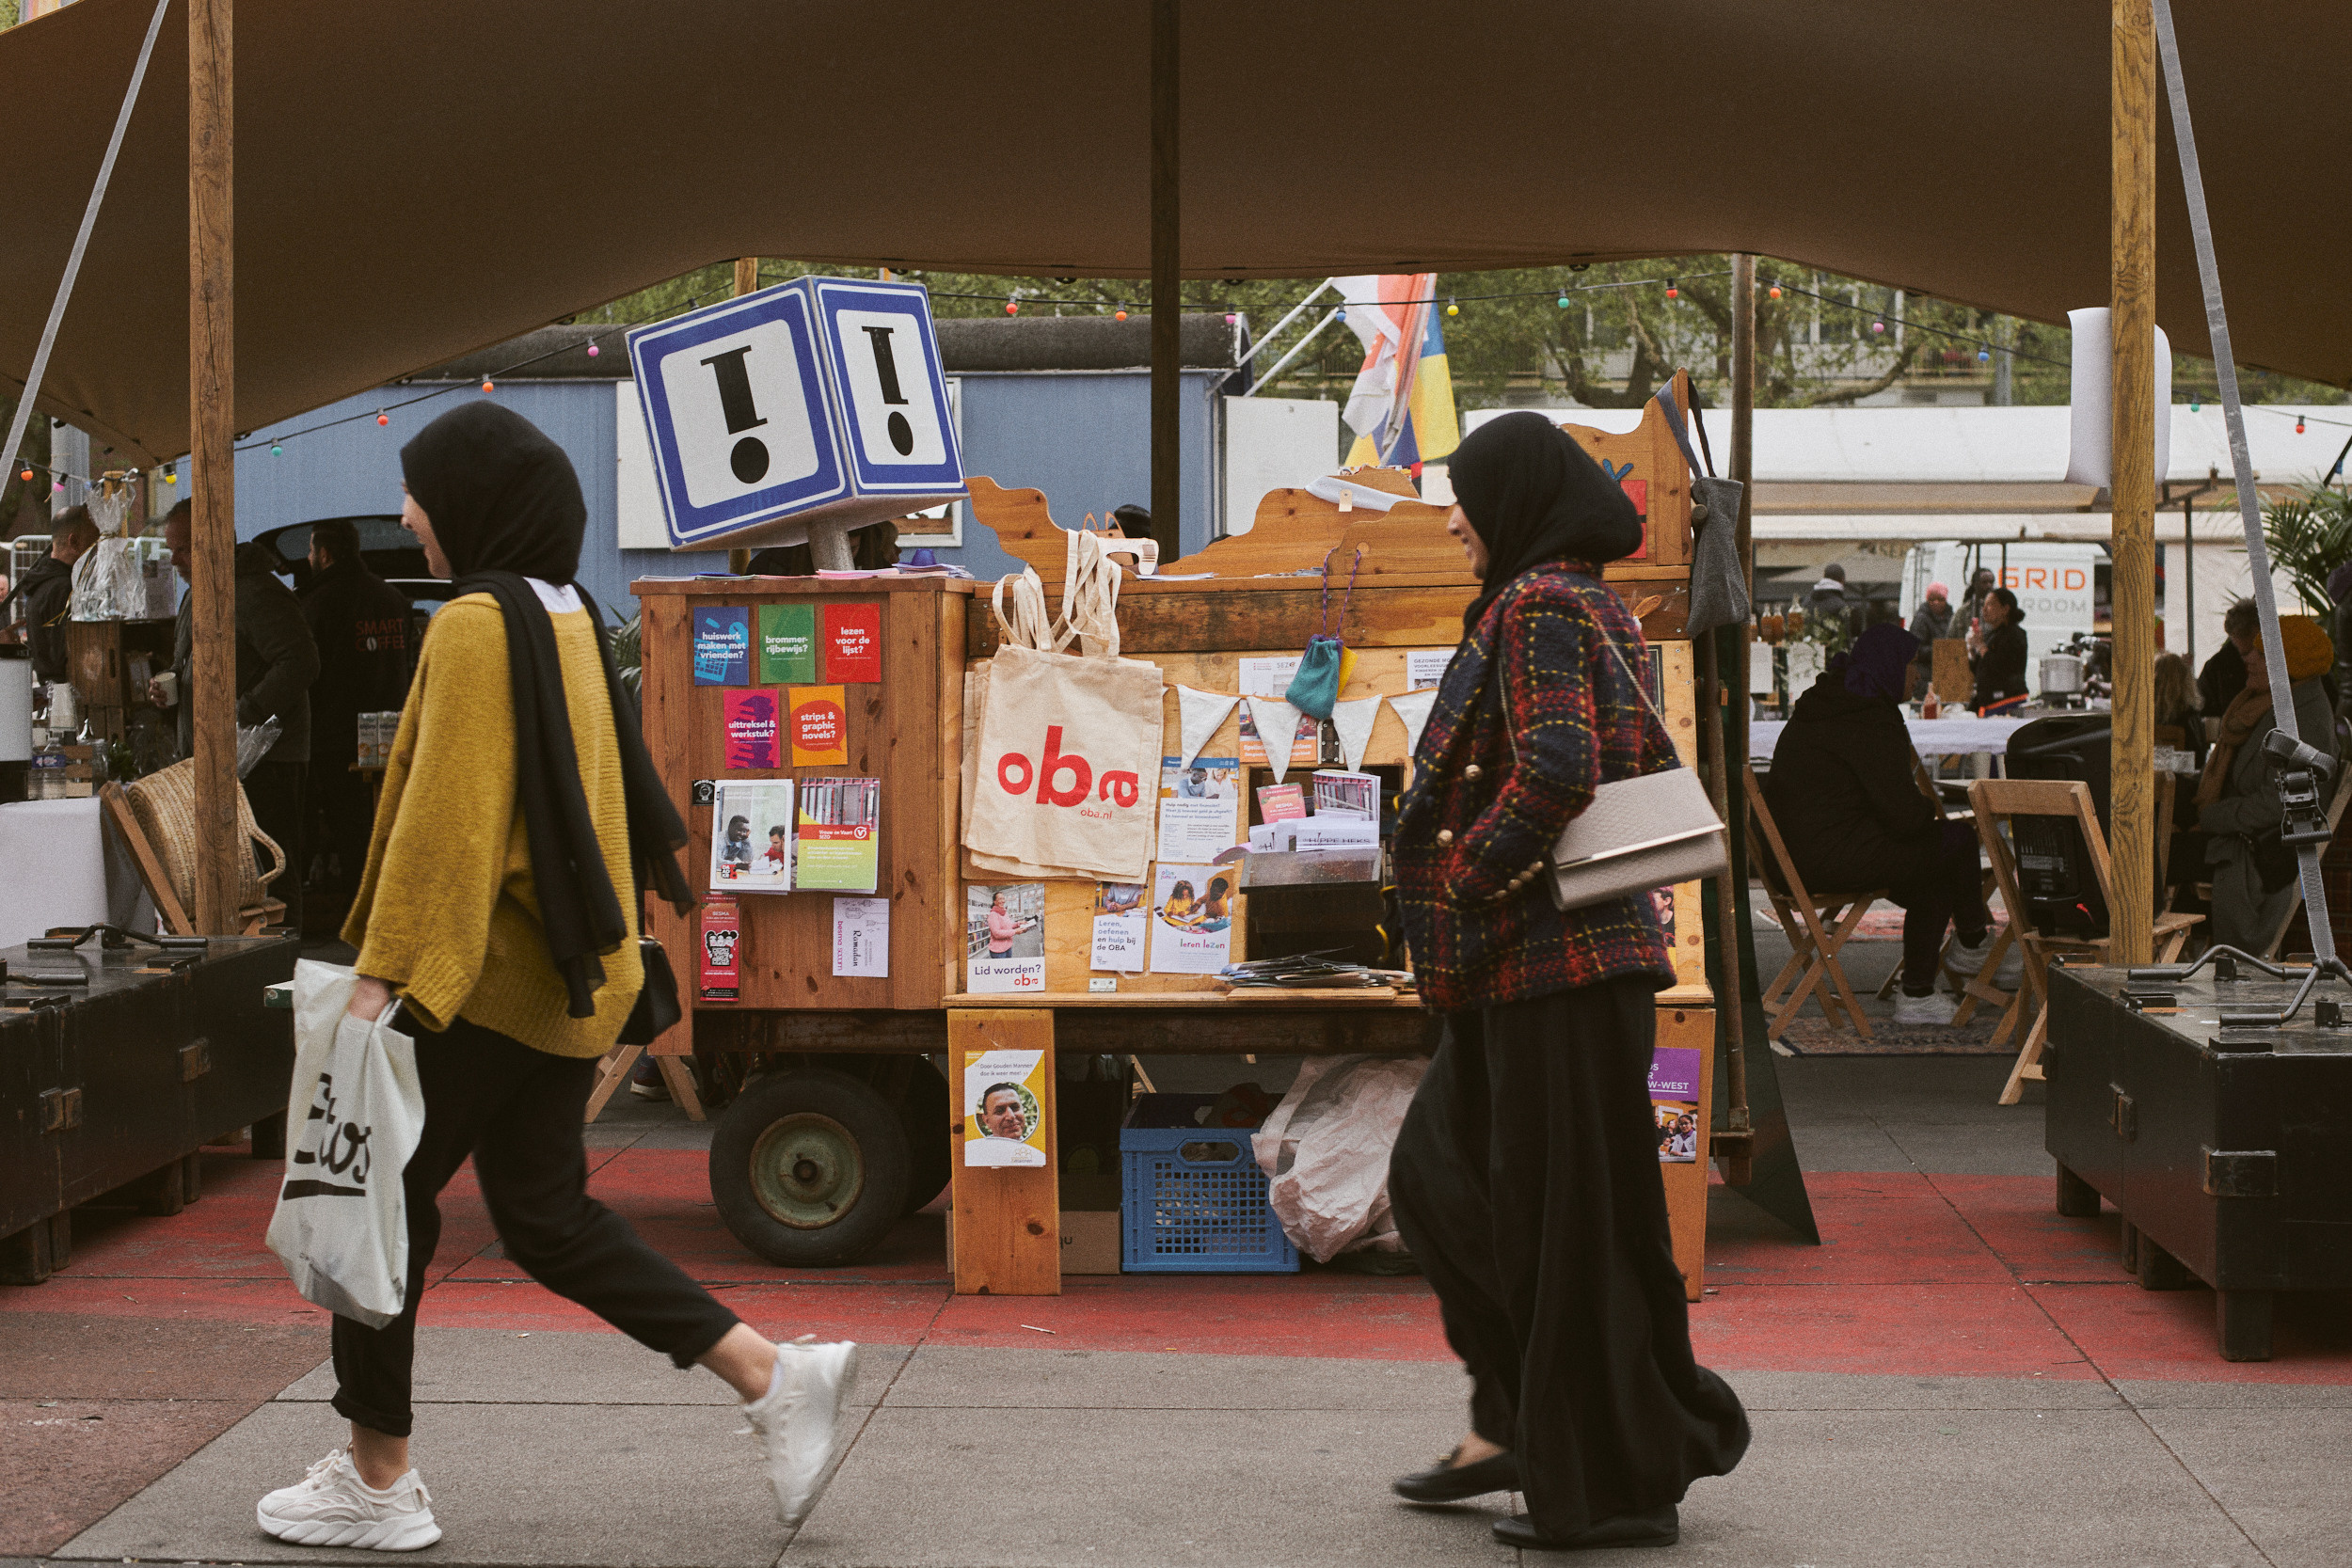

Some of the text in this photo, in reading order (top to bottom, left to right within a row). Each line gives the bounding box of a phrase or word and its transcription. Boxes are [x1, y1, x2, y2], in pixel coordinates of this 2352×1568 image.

[1999, 567, 2086, 590] GRID
[356, 618, 403, 635] SMART
[858, 636, 870, 644] de
[766, 645, 808, 655] rijbewijs?
[843, 646, 863, 656] lijst?
[800, 713, 826, 722] strips
[802, 722, 835, 732] graphic
[802, 731, 836, 740] novels?
[998, 725, 1139, 808] oba
[1080, 808, 1112, 820] oba.nl
[1108, 935, 1125, 944] hulp
[1127, 937, 1136, 945] bij
[1180, 938, 1225, 949] leren lezen
[853, 930, 861, 967] Ramadan
[975, 964, 1041, 975] Lid worden?
[1014, 974, 1038, 986] oba
